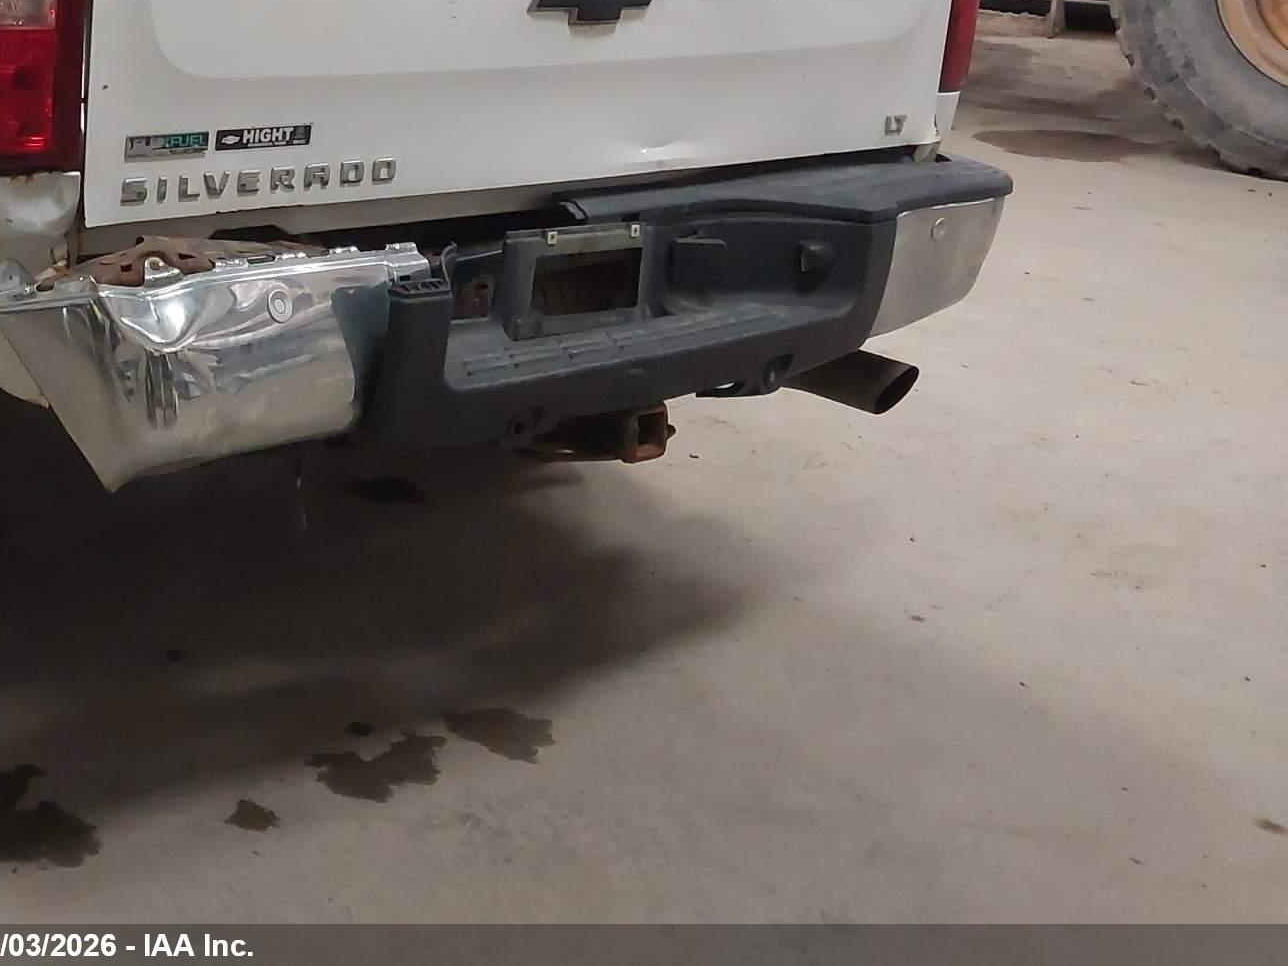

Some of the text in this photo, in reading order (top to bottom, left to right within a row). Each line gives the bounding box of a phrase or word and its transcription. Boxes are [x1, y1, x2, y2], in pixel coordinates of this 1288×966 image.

[242, 126, 294, 144] HIGHT
[884, 114, 908, 136] LT
[120, 157, 397, 206] SILVERADO
